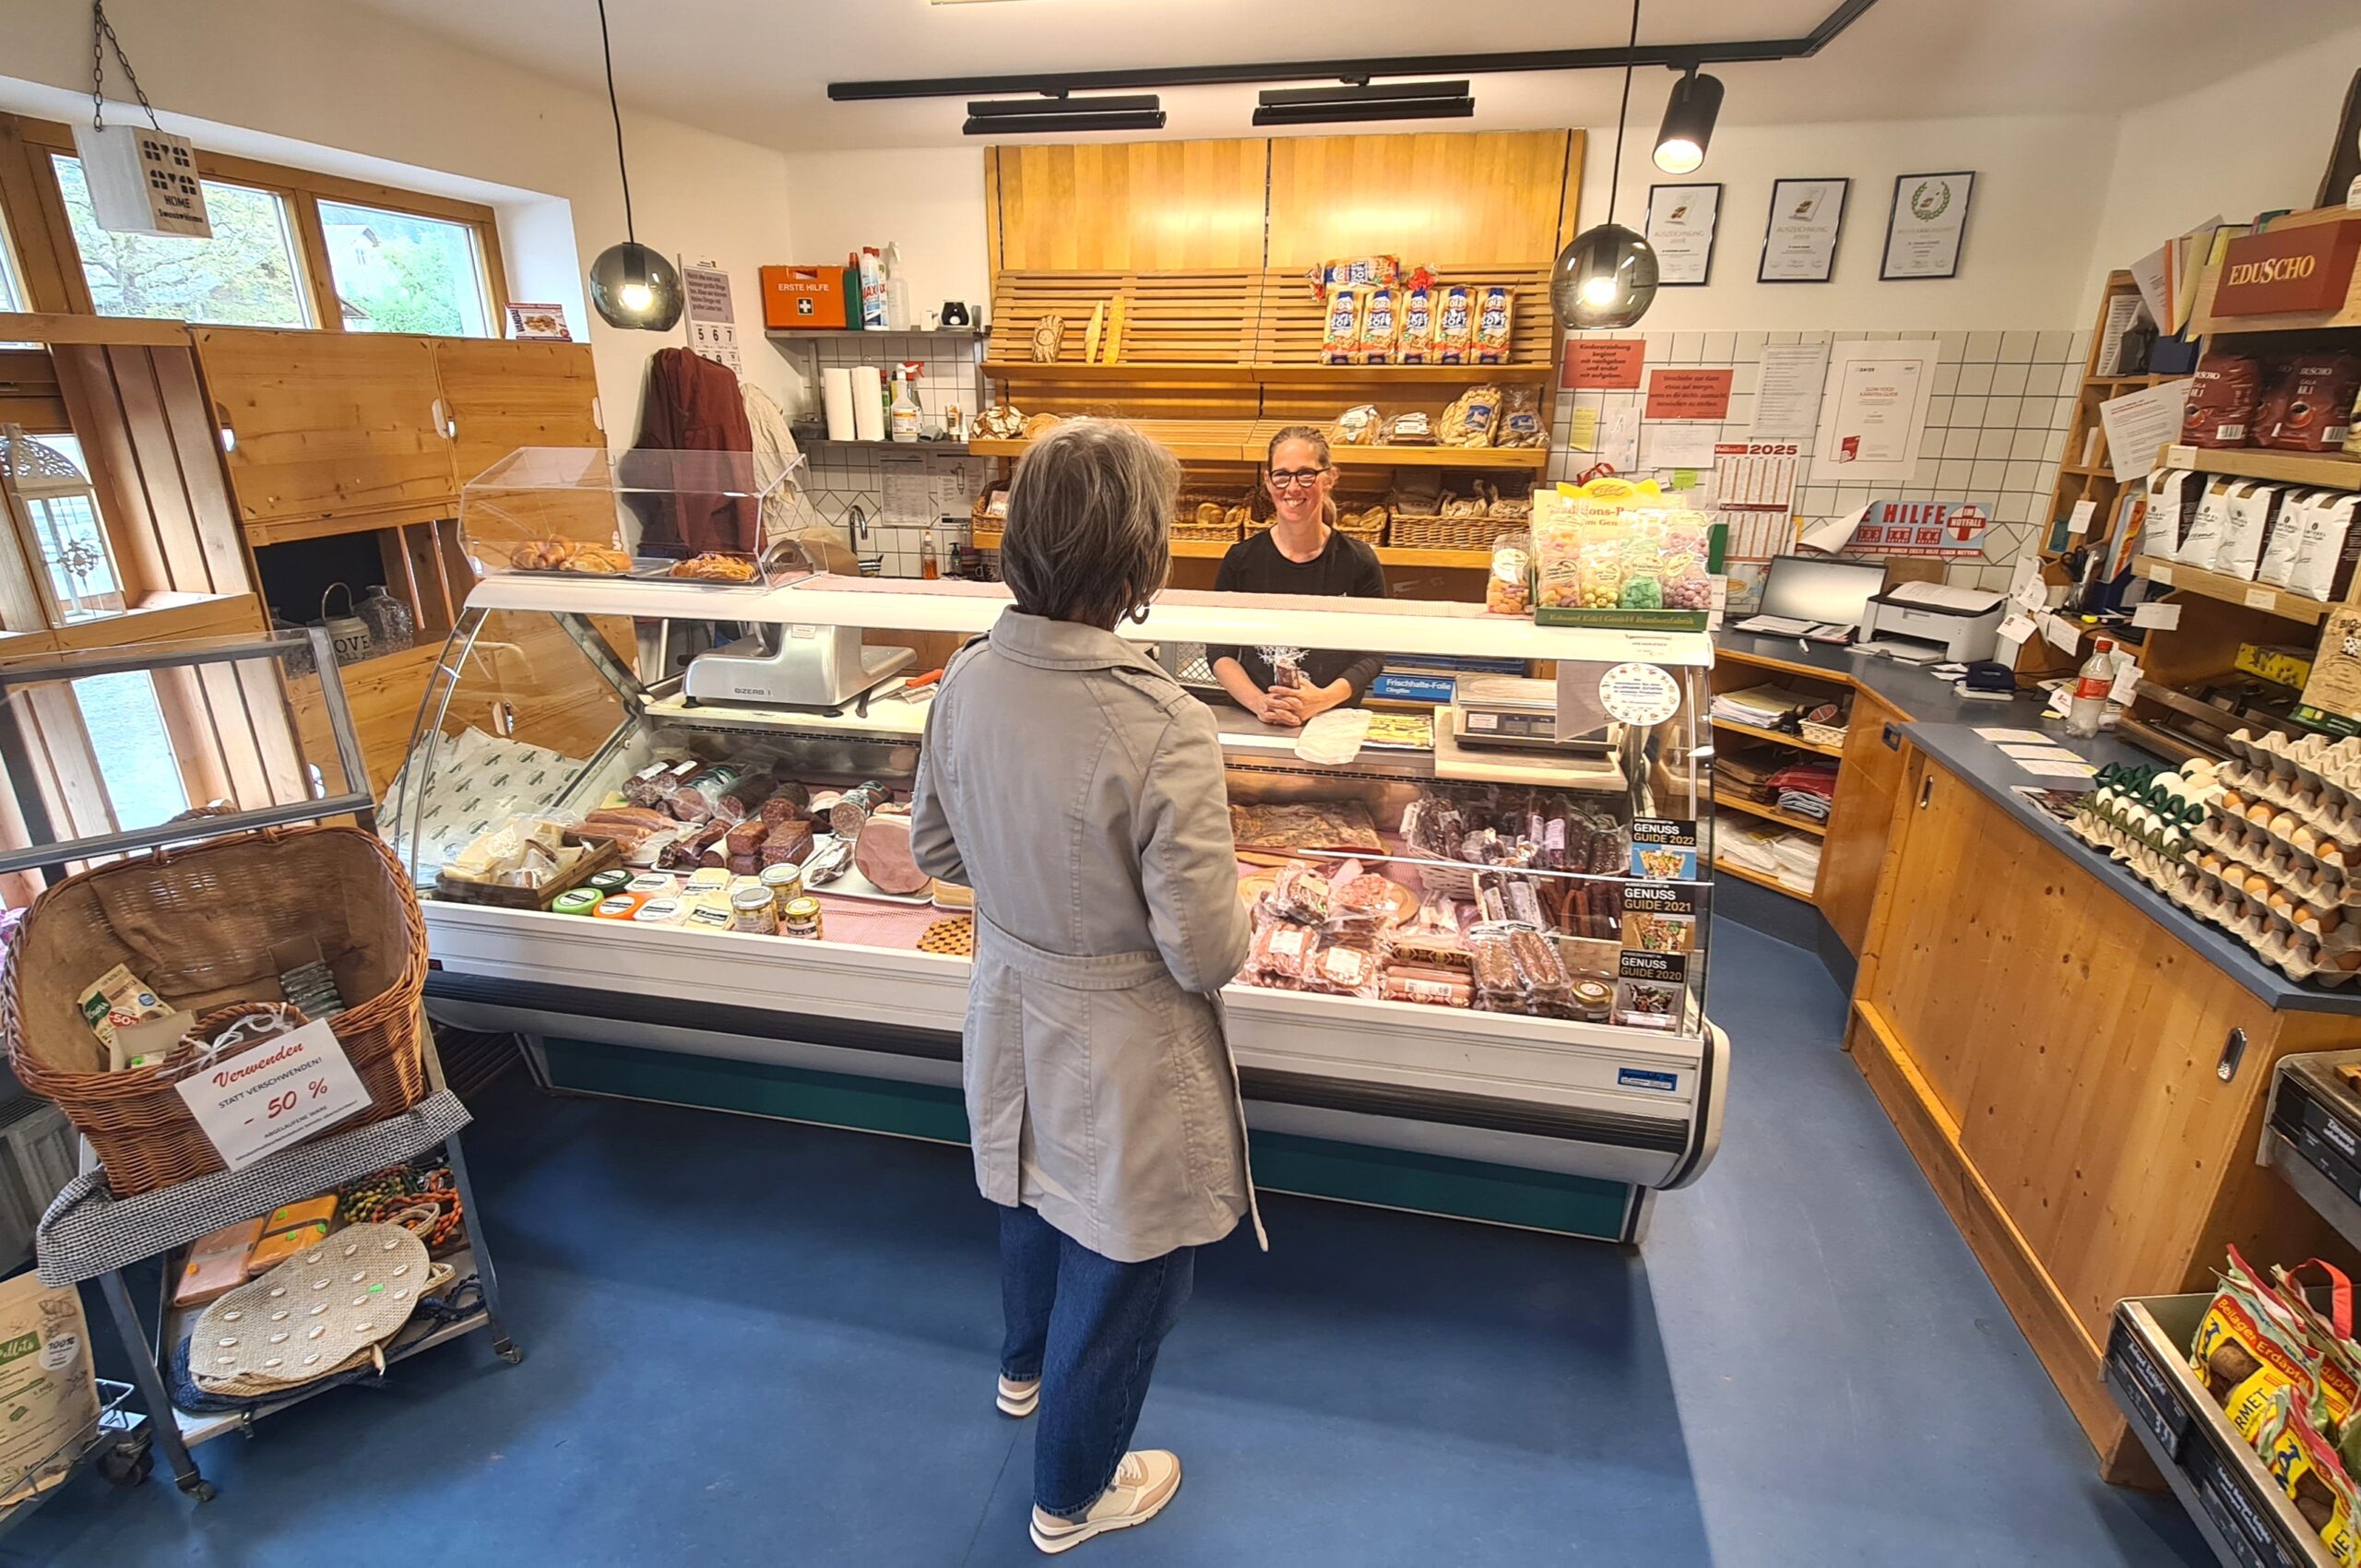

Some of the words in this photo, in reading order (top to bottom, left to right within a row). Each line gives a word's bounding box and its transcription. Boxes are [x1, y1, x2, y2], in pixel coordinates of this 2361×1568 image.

[164, 195, 192, 208] HOME
[2228, 255, 2316, 286] EDUSCHO
[778, 283, 804, 291] ERSTE
[1330, 318, 1356, 327] SOFT
[1442, 316, 1466, 326] SOFT
[698, 328, 705, 340] 5
[713, 329, 719, 341] 6
[727, 330, 732, 342] 7
[1750, 445, 1797, 455] 2025
[1882, 504, 1947, 524] HILFE
[1964, 508, 1975, 517] IM
[1951, 518, 1982, 528] NOTFALL
[1604, 615, 1634, 624] GmbH
[334, 635, 370, 653] OVE
[1386, 678, 1452, 690] Frischhalte-Folie
[1634, 823, 1679, 835] GENUSS
[1633, 833, 1667, 844] GUIDE
[1669, 836, 1694, 846] 2022
[1624, 887, 1676, 900] GENUSS
[1624, 899, 1662, 911] GUIDE
[1664, 901, 1691, 912] 2021
[1621, 956, 1667, 969] GENUSS
[1620, 967, 1654, 979] GUIDE
[1656, 968, 1682, 980] 2020
[212, 1042, 304, 1087] Verwenden
[219, 1092, 245, 1109] STATT
[247, 1056, 323, 1096] VERSCHWENDEN!
[268, 1090, 298, 1120] 50
[309, 1077, 328, 1099] %
[310, 1105, 327, 1117] WARE
[48, 1336, 76, 1350] 100%
[2319, 1365, 2355, 1398] däpfe
[2234, 1387, 2270, 1431] RMET
